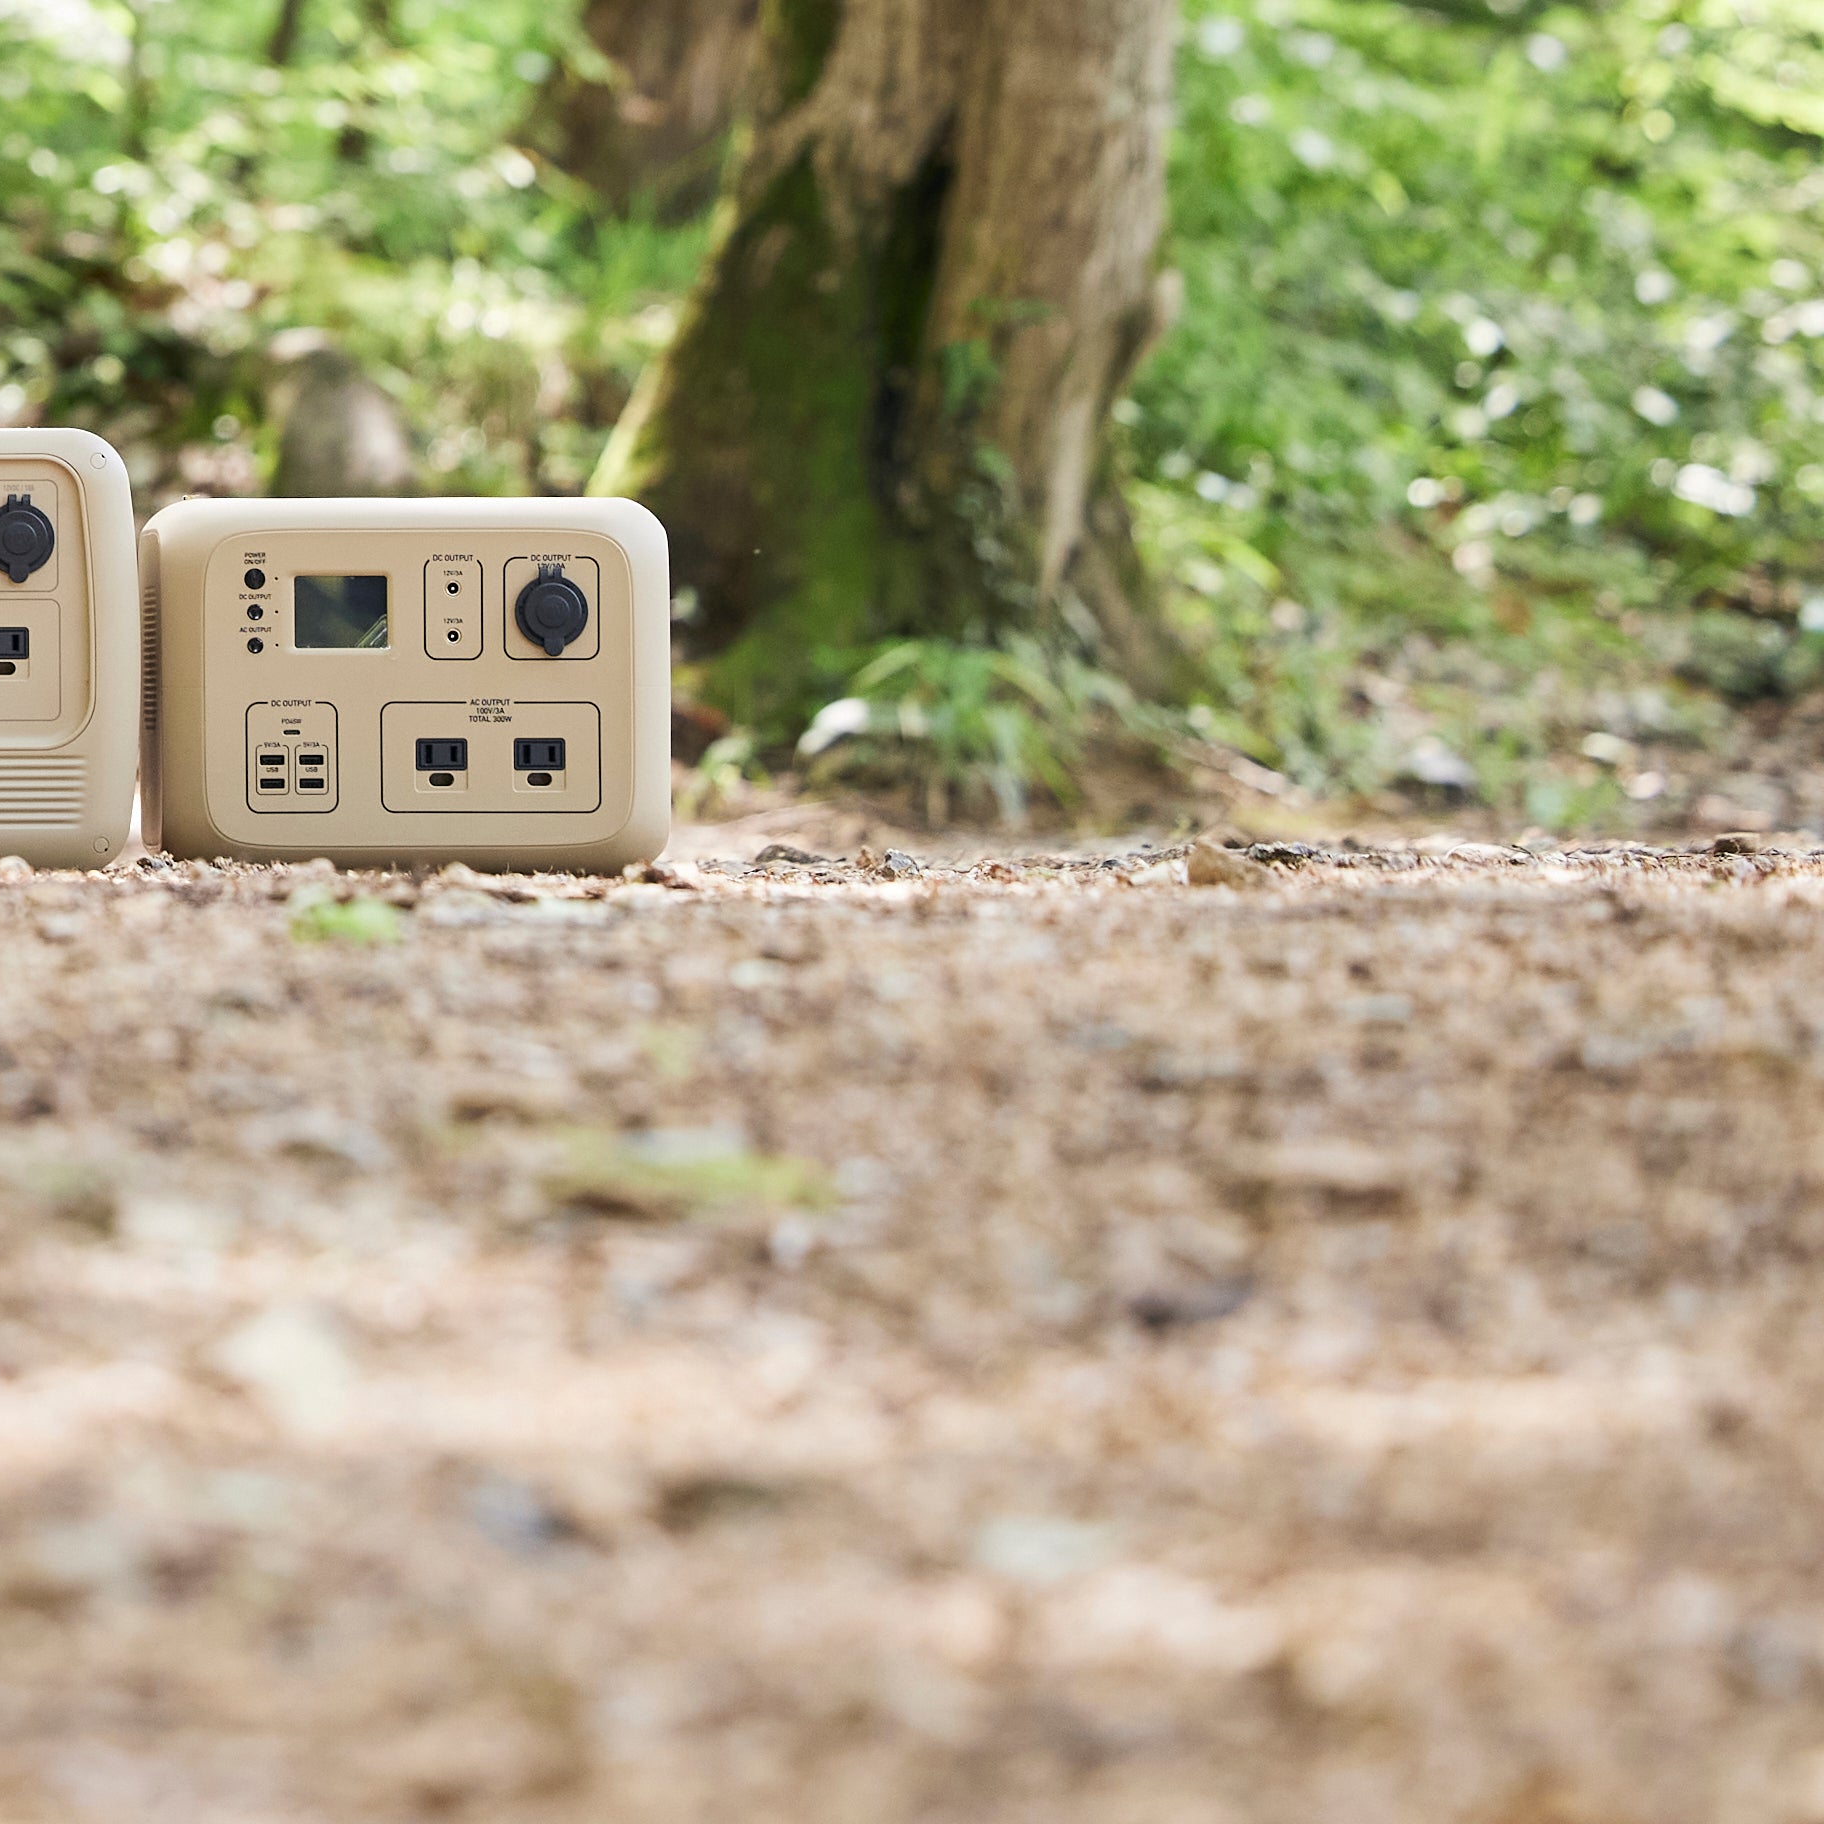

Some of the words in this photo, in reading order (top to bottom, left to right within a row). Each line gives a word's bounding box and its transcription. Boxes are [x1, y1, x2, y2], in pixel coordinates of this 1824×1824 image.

[432, 554, 443, 562] DC
[444, 554, 474, 562] OUTPUT
[530, 554, 541, 562] DC
[542, 554, 572, 562] OUTPUT
[282, 699, 312, 707] OUTPUT
[470, 698, 480, 706] AC
[481, 698, 510, 706] OUTPUT
[469, 715, 491, 723] TOTAL
